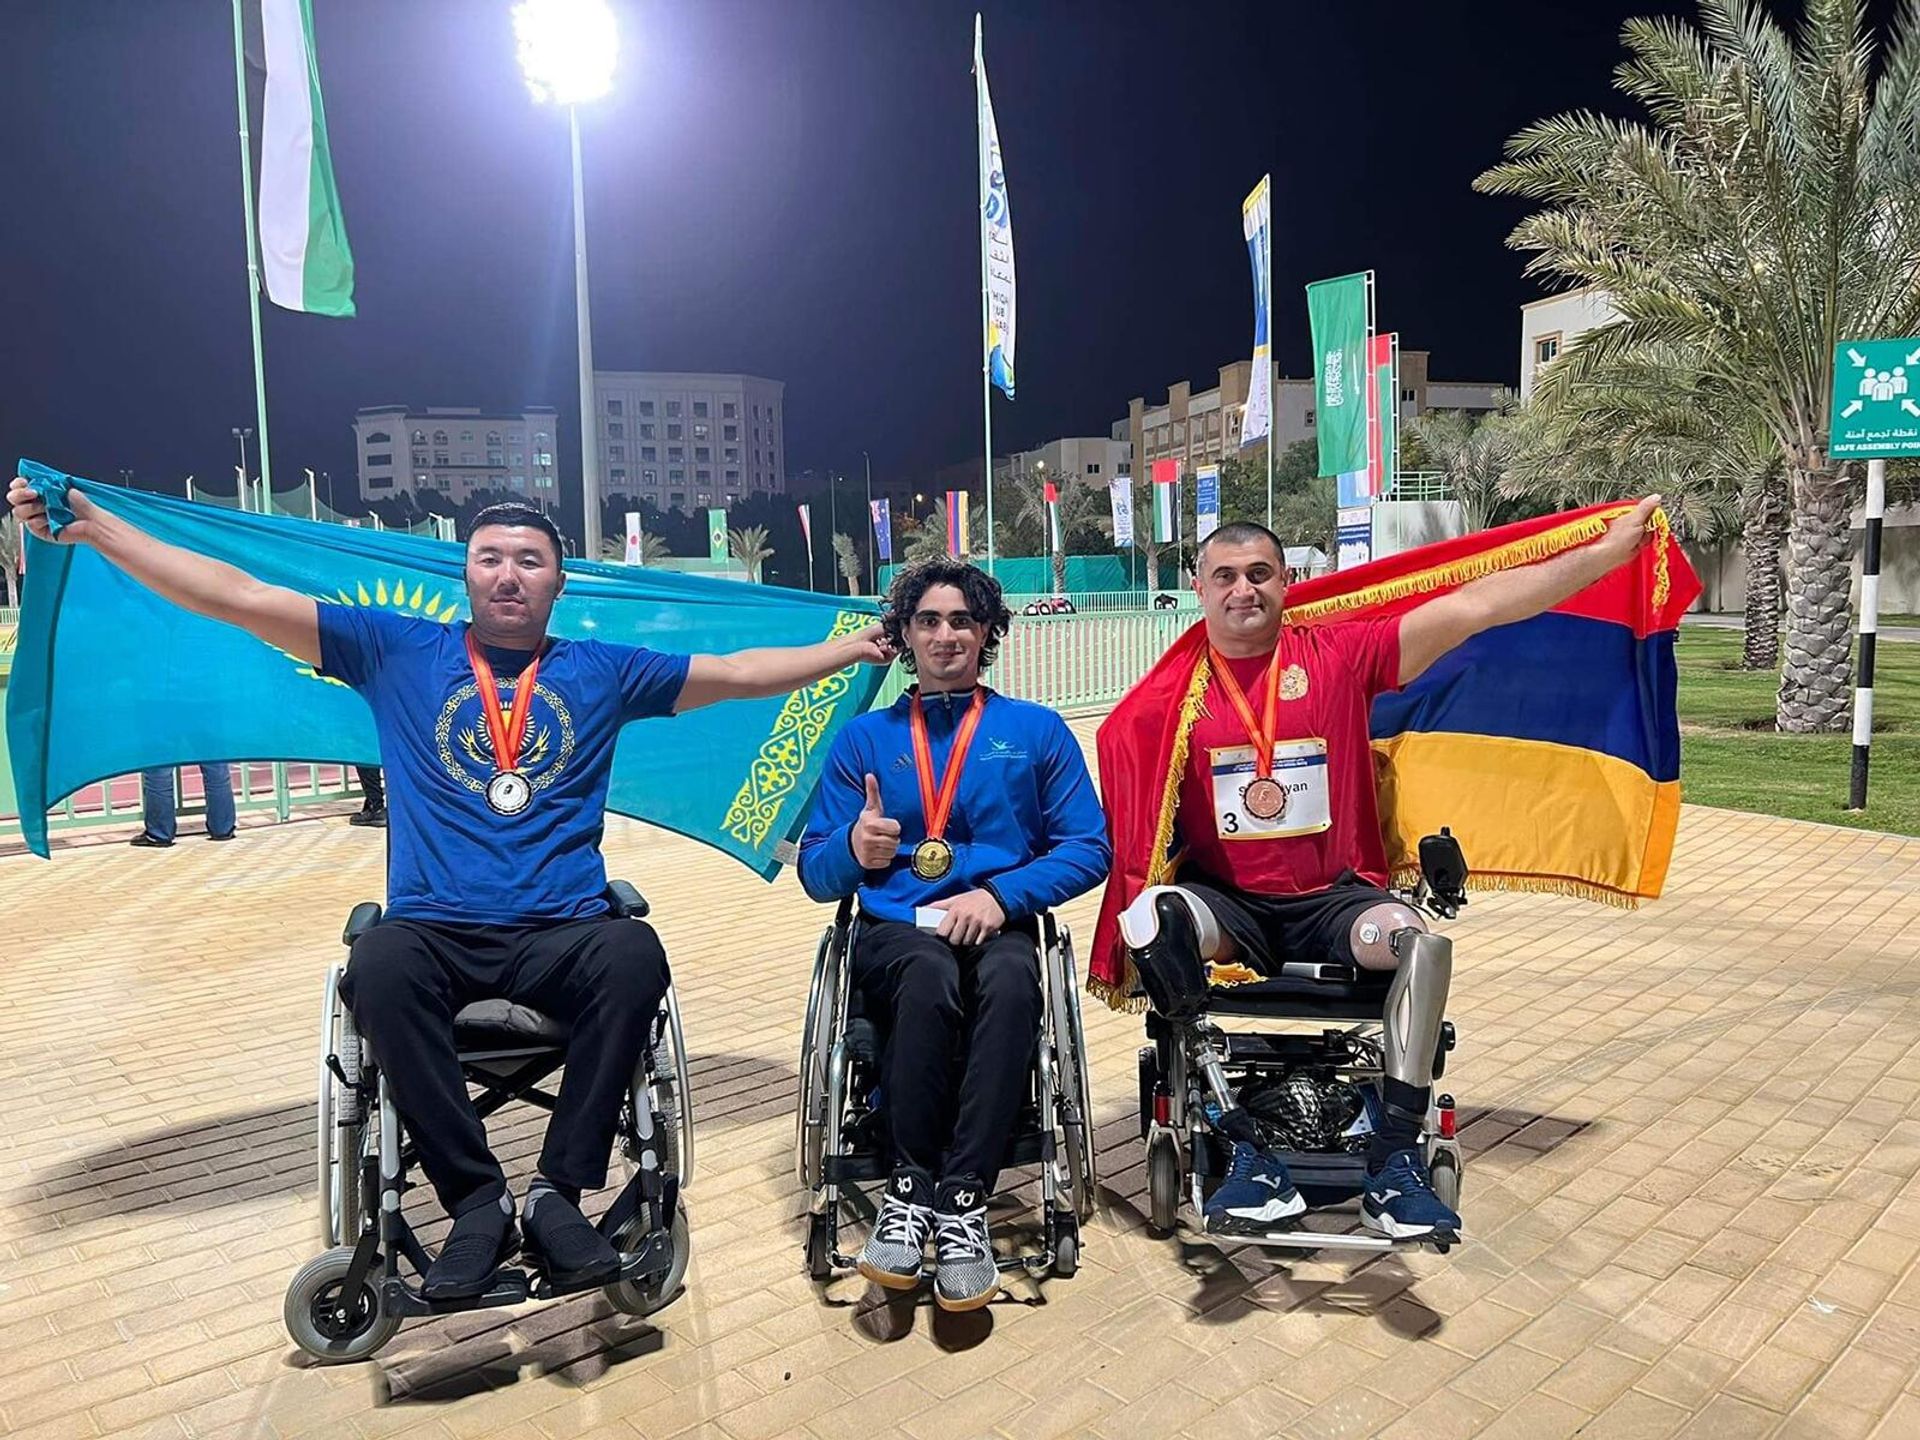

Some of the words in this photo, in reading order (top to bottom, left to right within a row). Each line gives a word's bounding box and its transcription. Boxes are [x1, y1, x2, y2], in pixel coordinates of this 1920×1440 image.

[1866, 429, 1891, 441] تجمع
[1892, 428, 1918, 437] نقطة
[1834, 443, 1856, 451] SAFE
[1856, 441, 1900, 451] ASSEMBLY
[1901, 441, 1920, 449] POIN
[1223, 812, 1239, 833] 3
